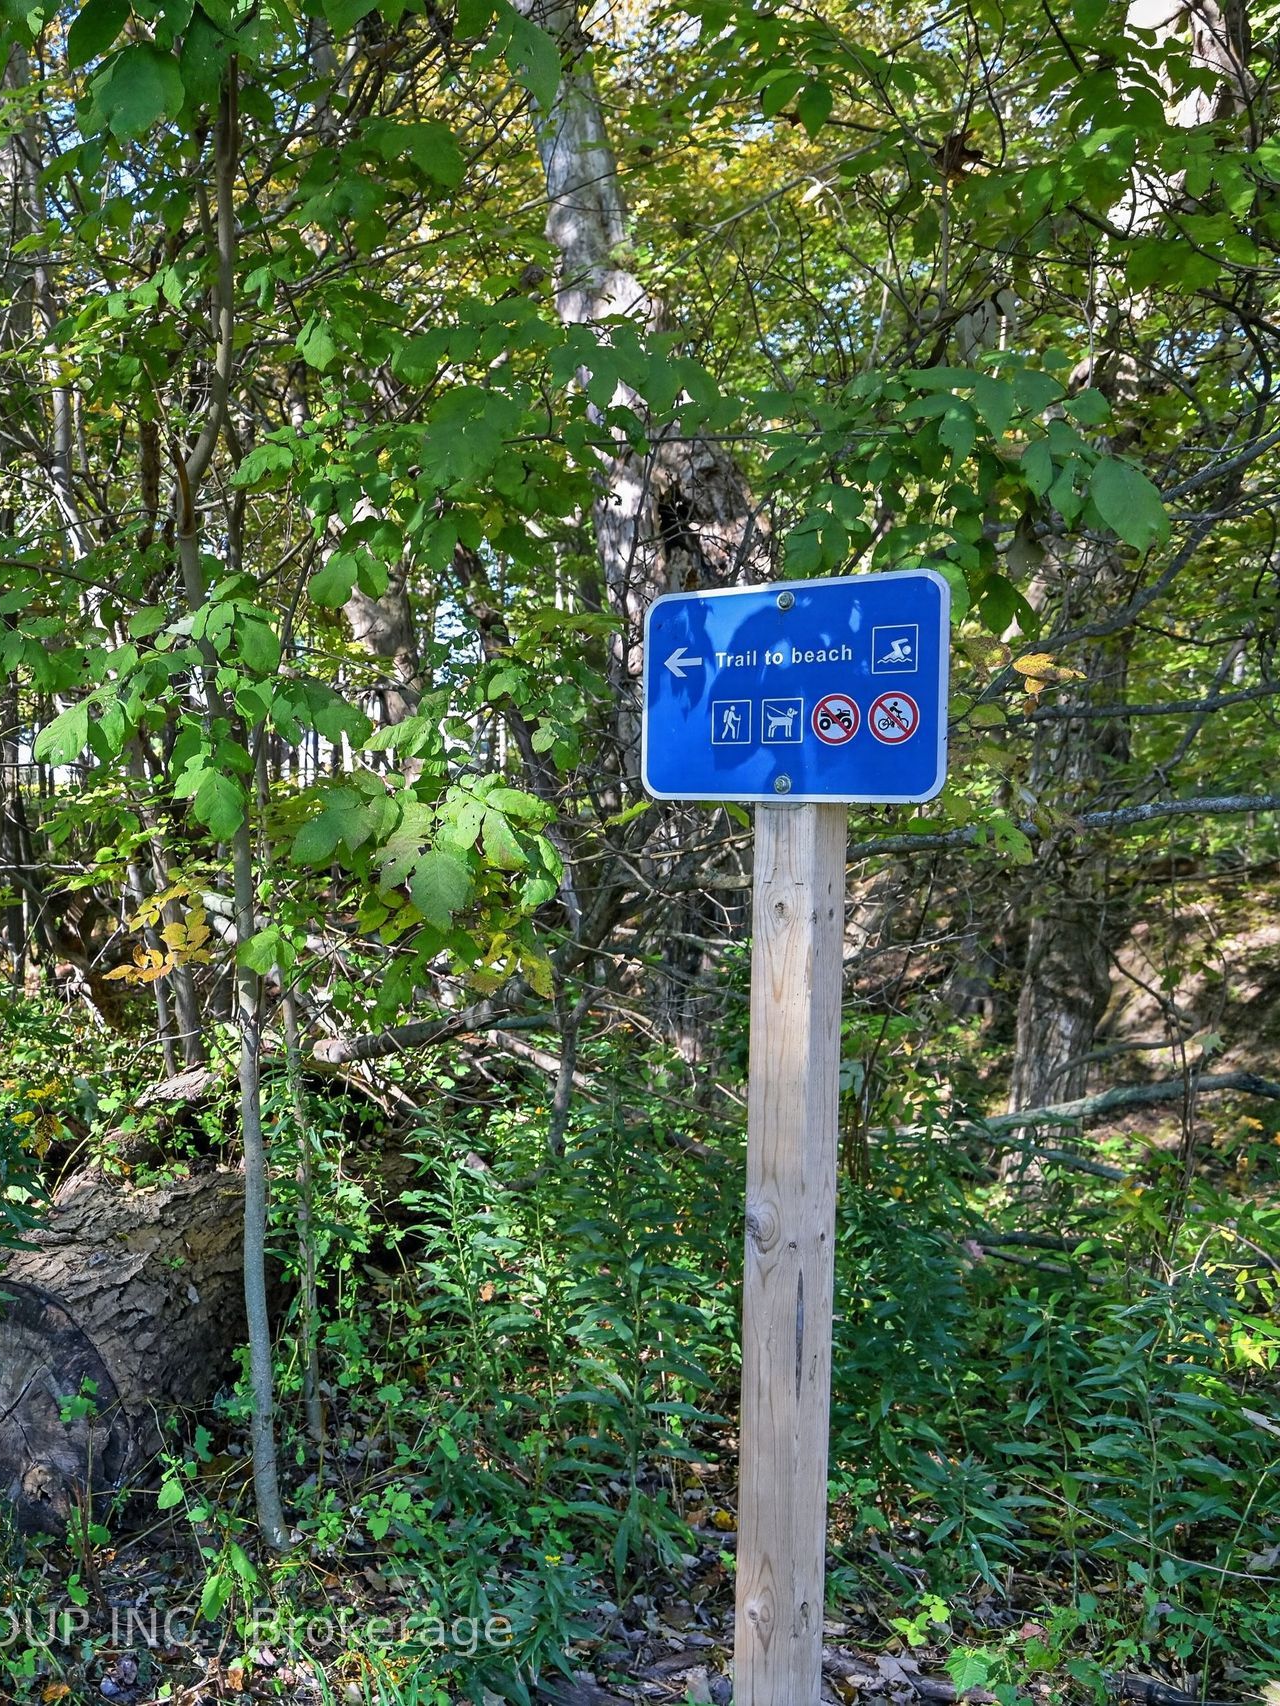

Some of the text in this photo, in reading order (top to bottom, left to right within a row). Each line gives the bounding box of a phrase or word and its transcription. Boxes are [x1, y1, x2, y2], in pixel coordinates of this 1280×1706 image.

[716, 644, 852, 668] Trail to beach
